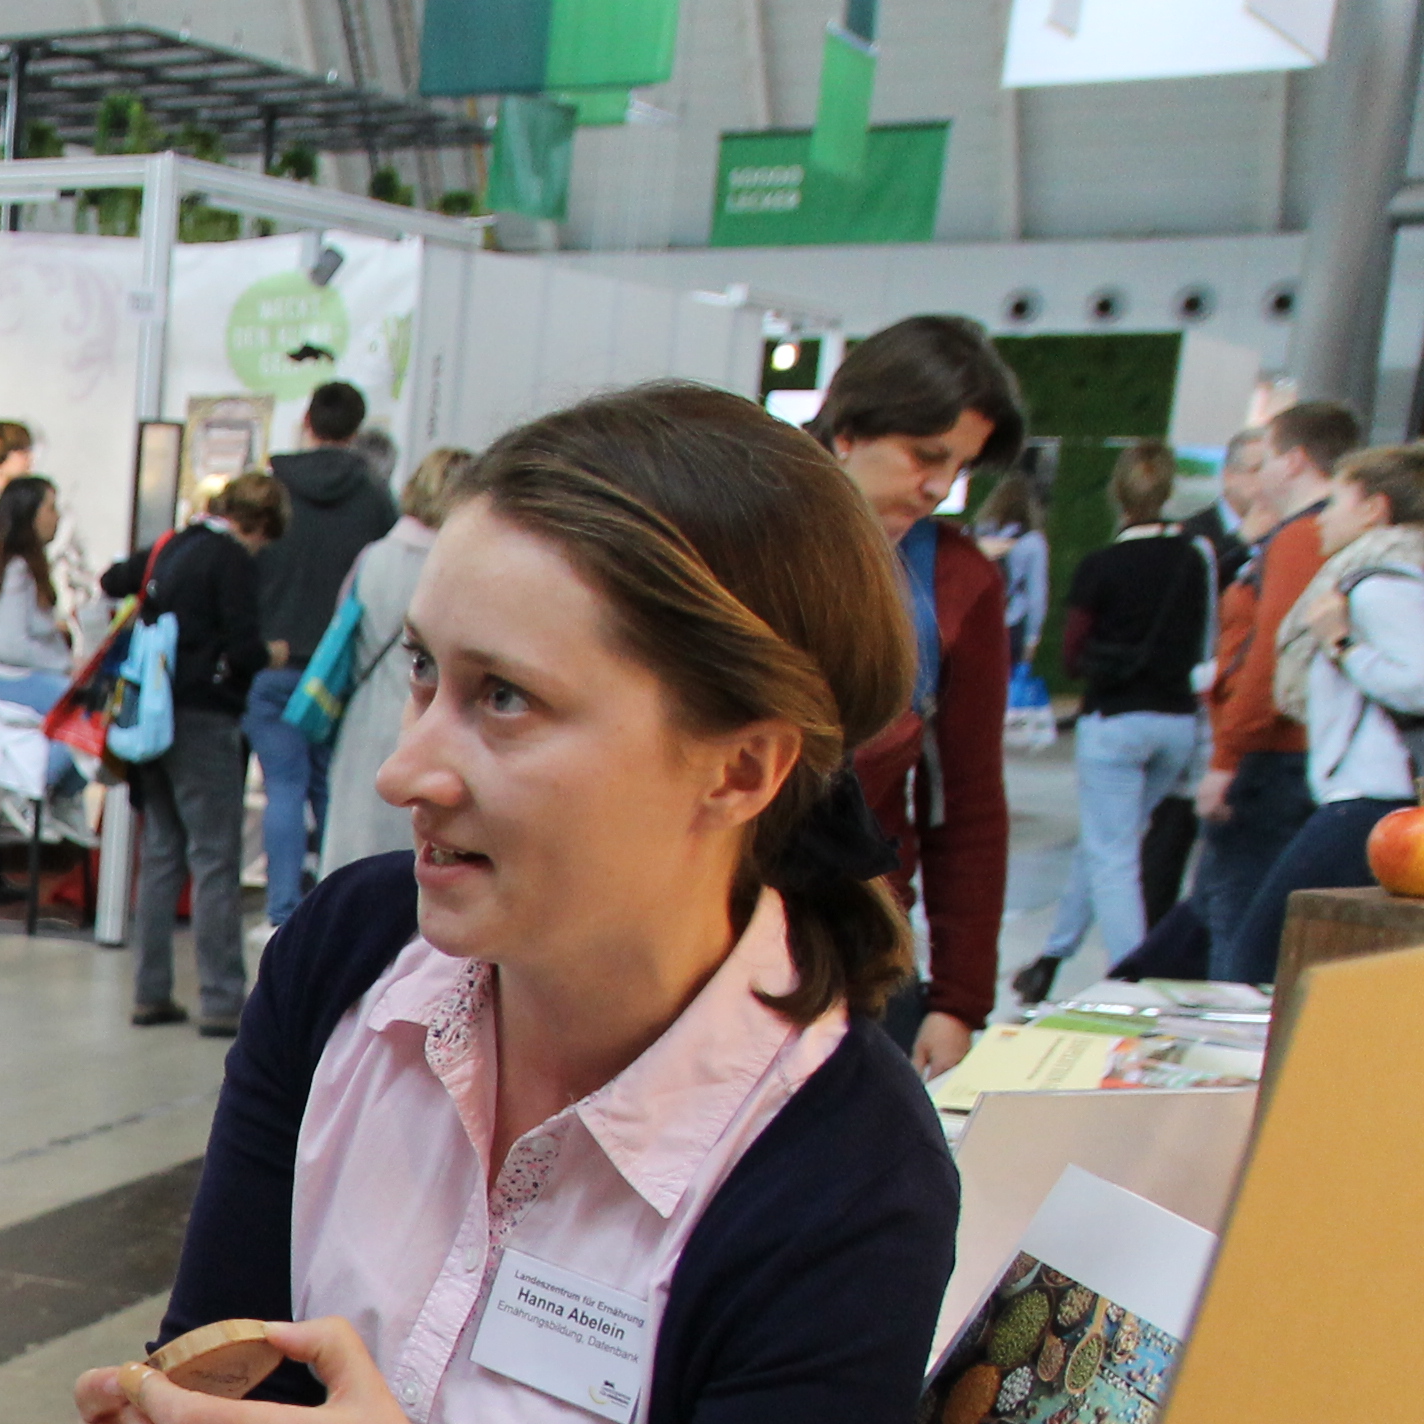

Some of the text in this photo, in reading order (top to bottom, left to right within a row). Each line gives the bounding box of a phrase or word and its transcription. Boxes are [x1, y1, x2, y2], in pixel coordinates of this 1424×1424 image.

[514, 1269, 645, 1329] Landeszentrum für Ernährung
[517, 1286, 626, 1341] Hanna Abelein
[587, 1335, 640, 1364] Datenbank
